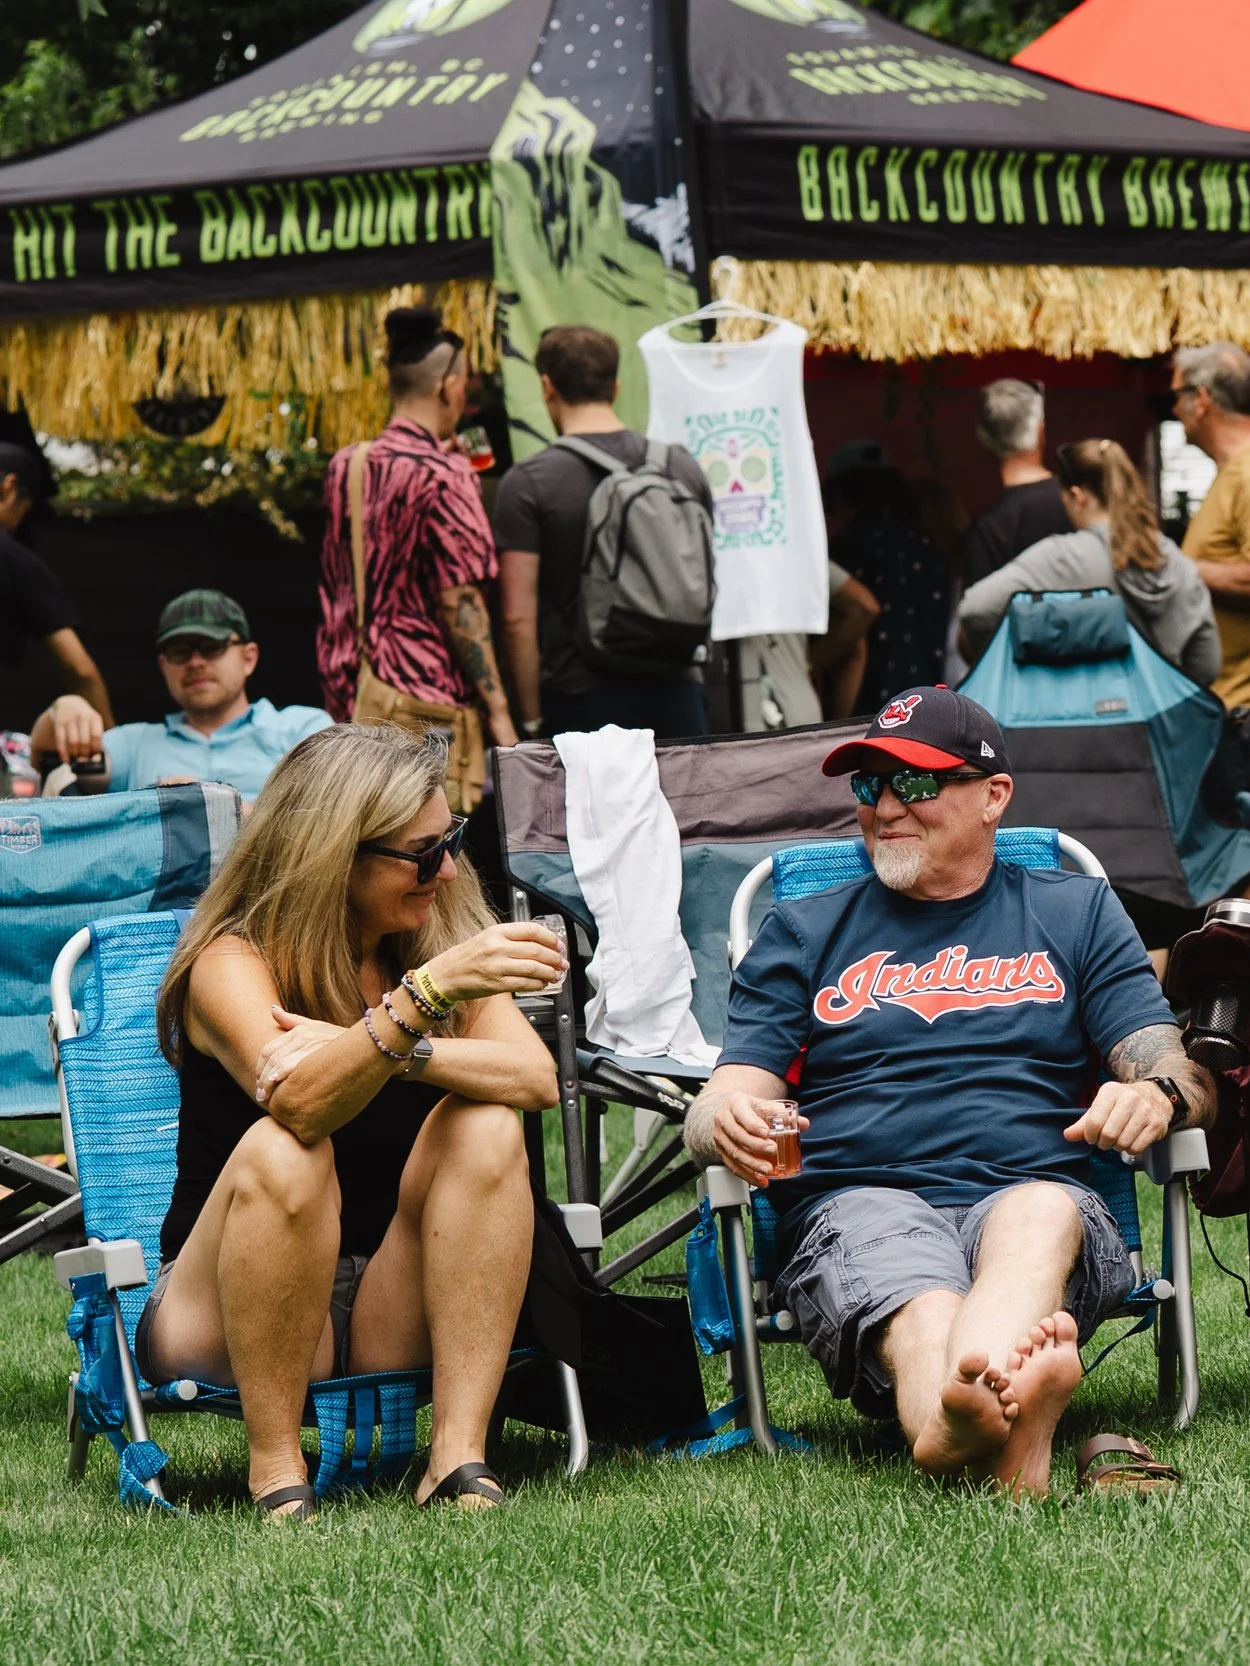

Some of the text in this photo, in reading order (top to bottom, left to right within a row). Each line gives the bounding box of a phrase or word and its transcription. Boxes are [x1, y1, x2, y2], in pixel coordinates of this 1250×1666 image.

[8, 161, 492, 282] HIT THE BACKCOUNTRY
[797, 145, 1110, 226] BACKCOUNTRY
[1, 834, 38, 846] TIMBER
[813, 944, 1066, 1025] Indians
